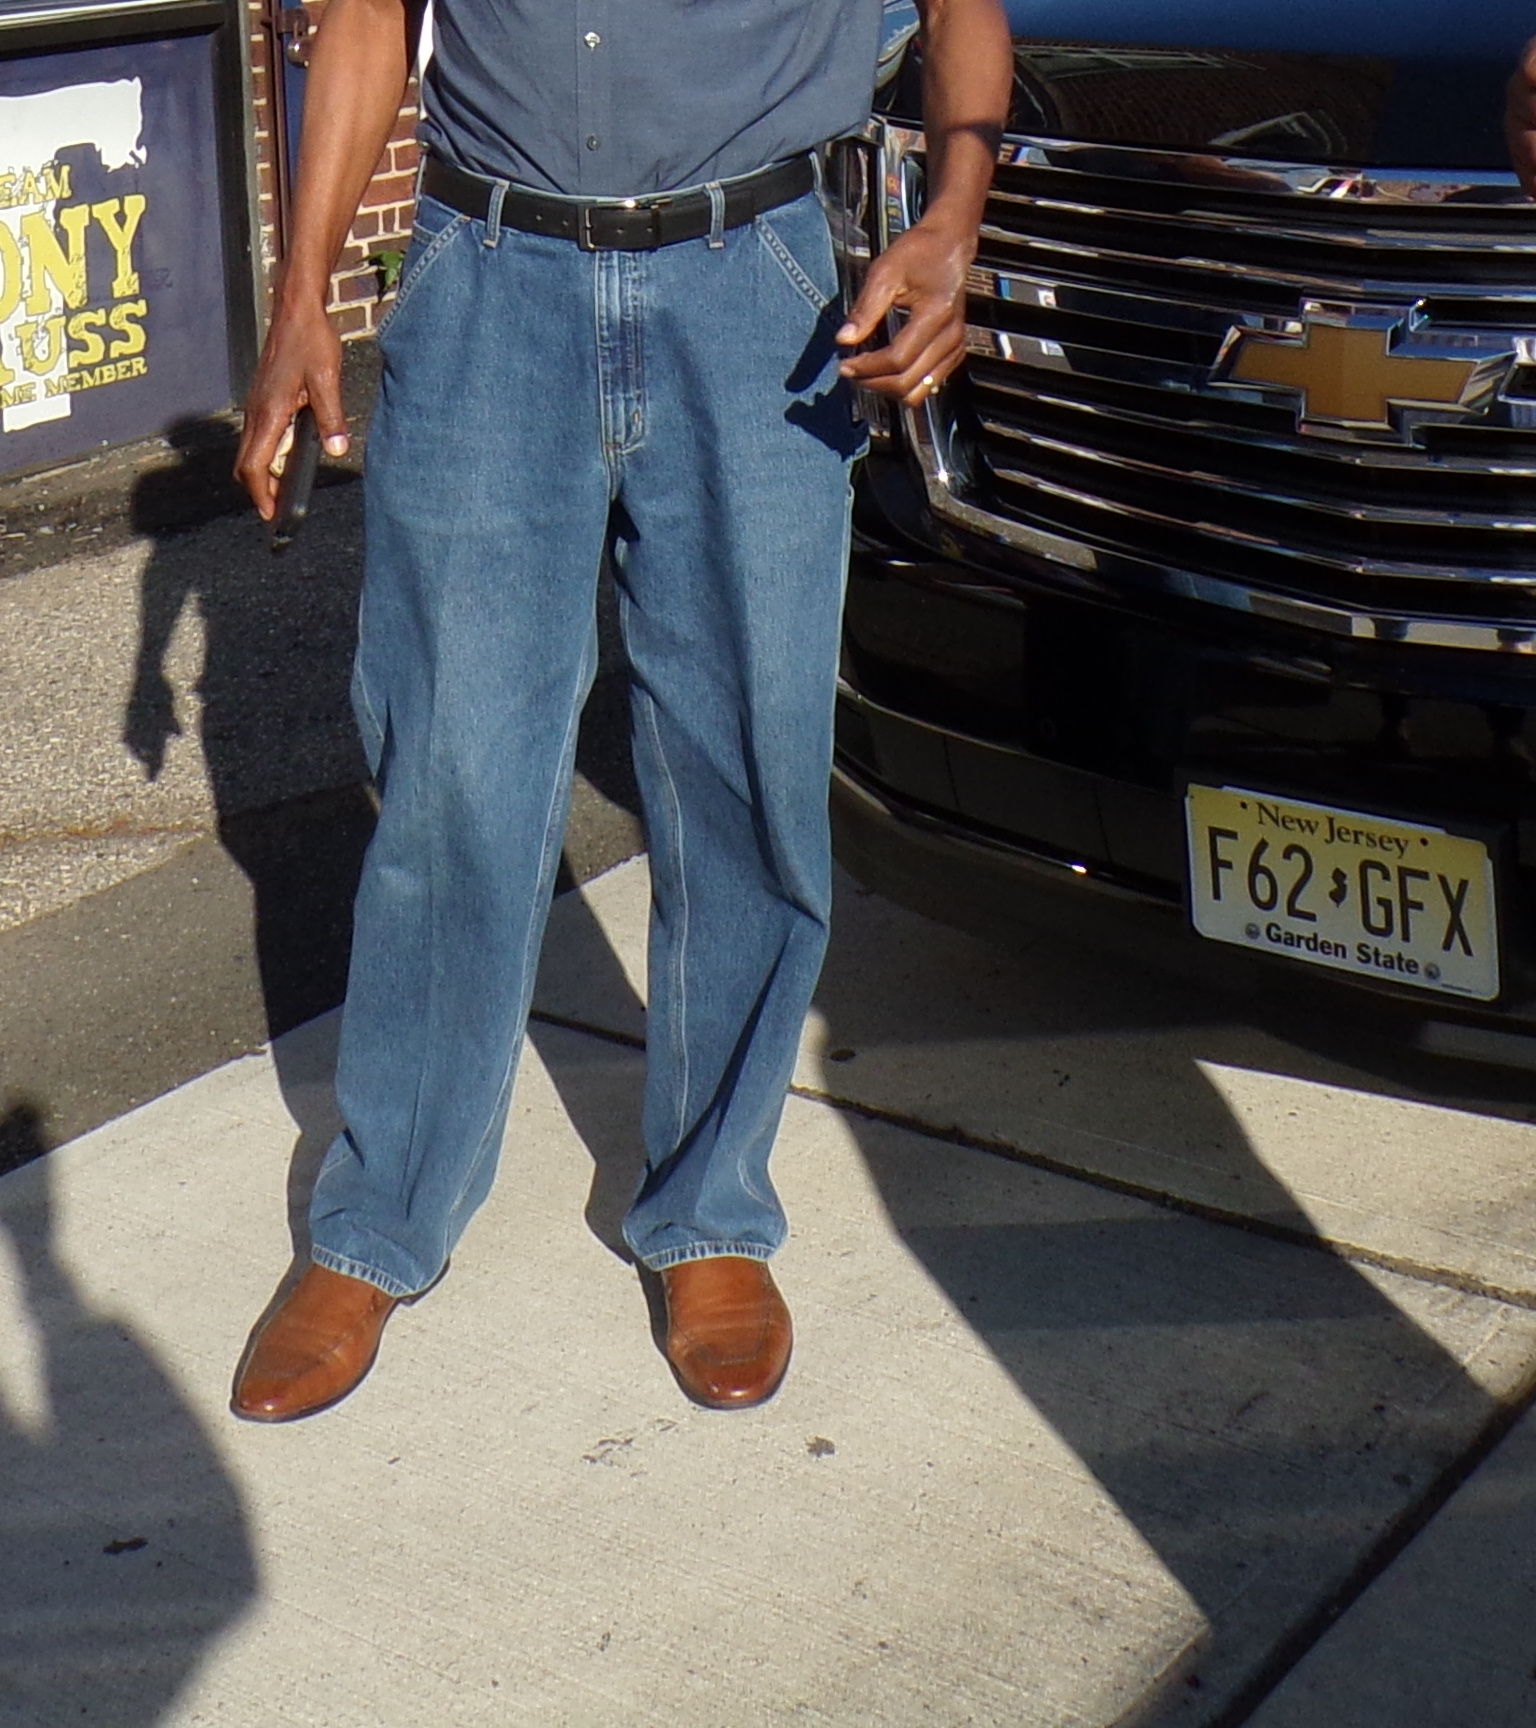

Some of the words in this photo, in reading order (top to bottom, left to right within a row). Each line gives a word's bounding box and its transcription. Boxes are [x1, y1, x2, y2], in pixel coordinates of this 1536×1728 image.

[44, 356, 148, 399] MEMBER
[1256, 802, 1319, 836] New
[1325, 814, 1410, 859] Jersey
[1207, 825, 1318, 923] F62
[1358, 858, 1475, 958] GFX
[1265, 922, 1348, 960] Garden
[1356, 942, 1420, 976] State
